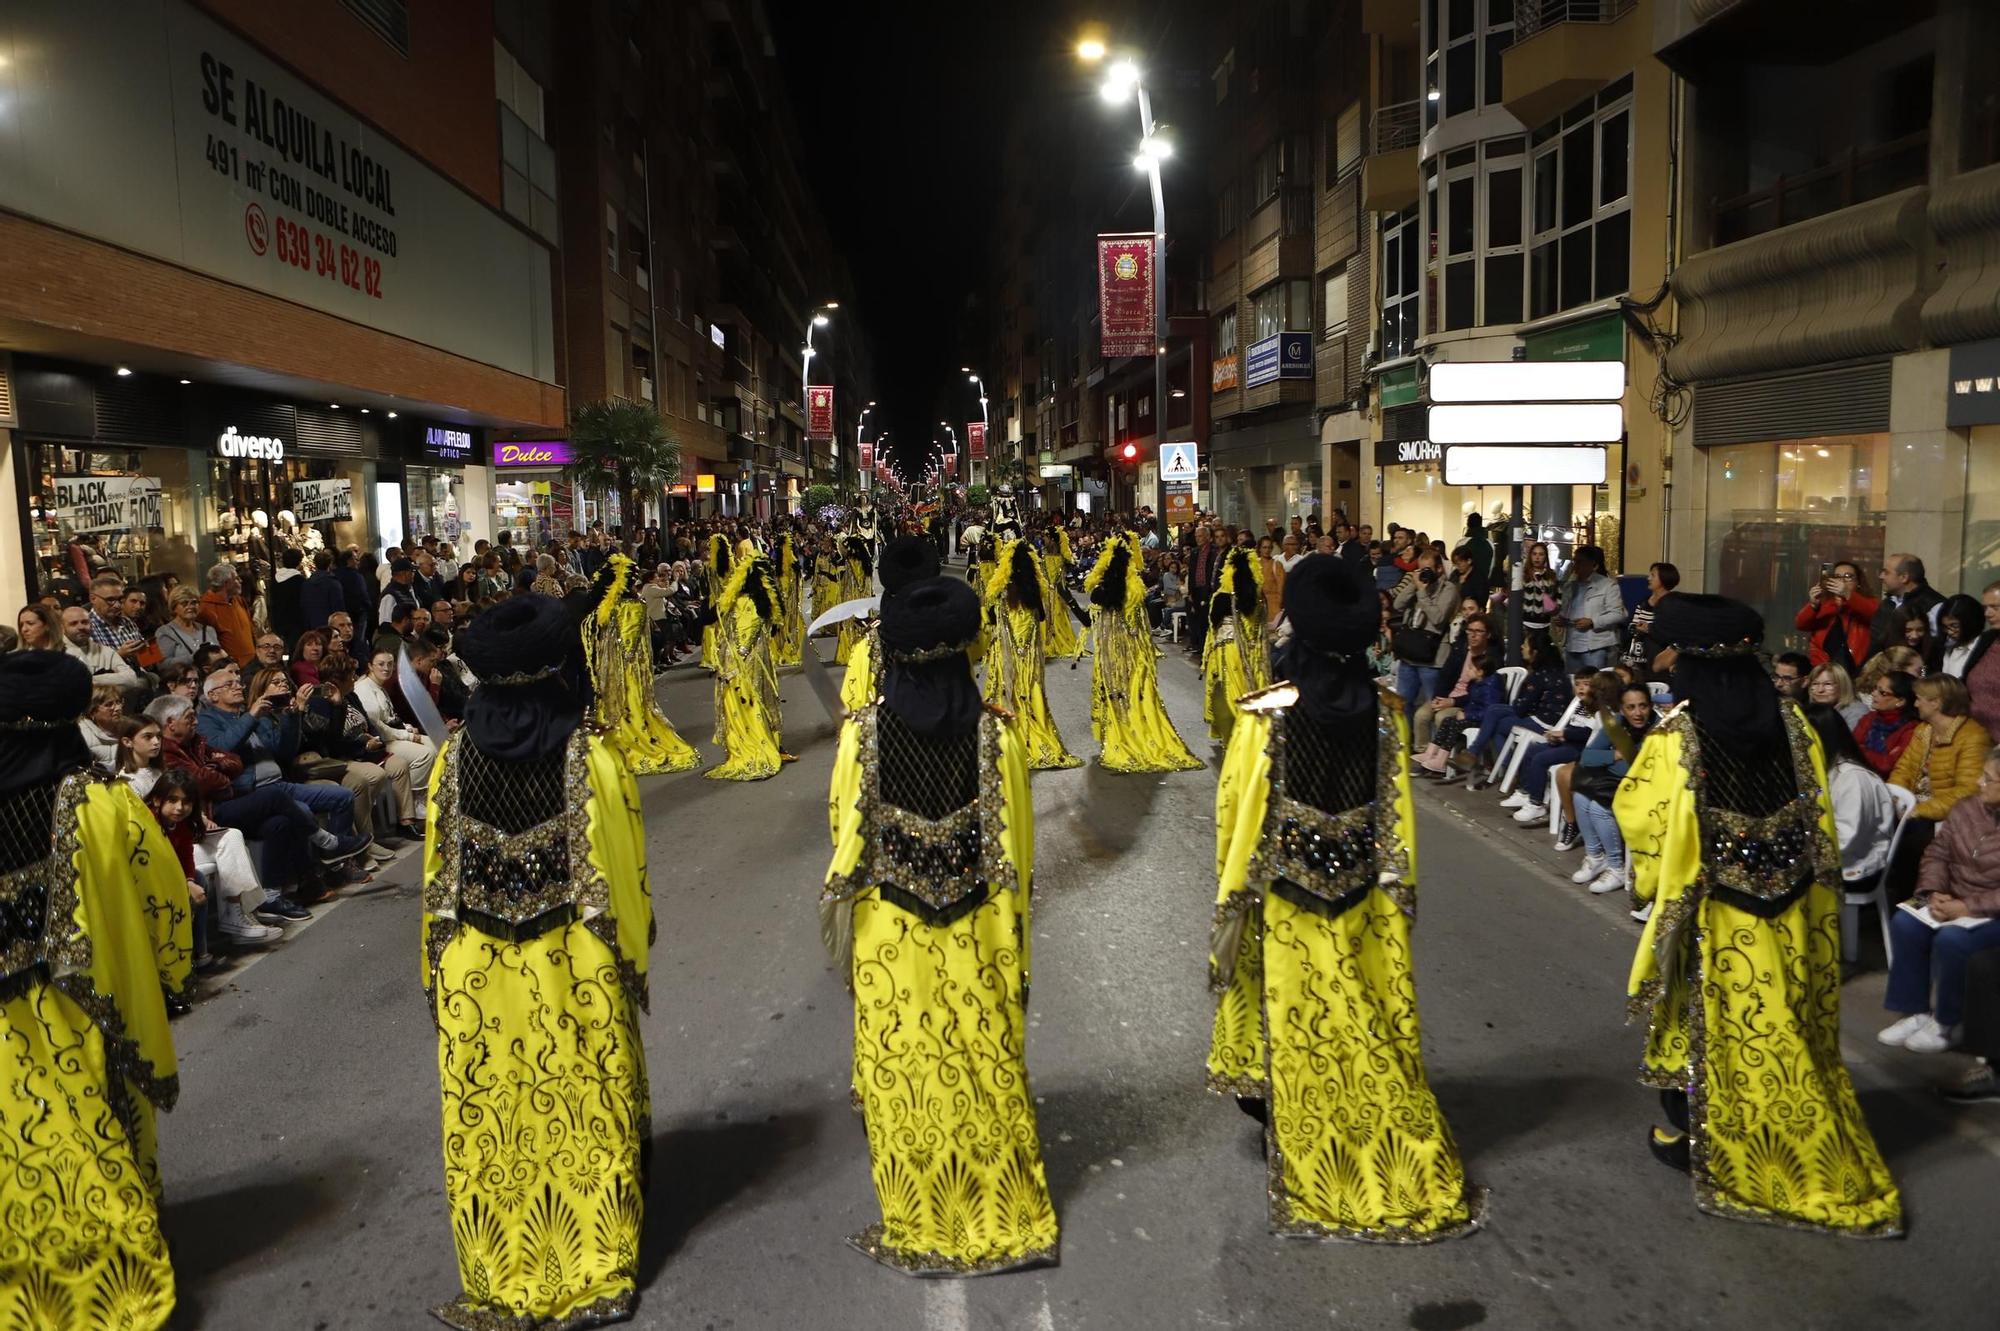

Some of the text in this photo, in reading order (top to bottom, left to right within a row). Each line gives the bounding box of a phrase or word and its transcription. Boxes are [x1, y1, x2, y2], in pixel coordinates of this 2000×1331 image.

[201, 51, 396, 217] SE ALQUILA LOCAL
[206, 134, 239, 181] 491
[269, 167, 302, 213] CON
[306, 186, 349, 236] DOBLE
[352, 212, 397, 258] ACCESO
[276, 216, 383, 300] 639 34 62 82
[219, 425, 284, 462] diverso
[501, 445, 553, 463] Dulce
[57, 481, 107, 508] BLACK
[294, 483, 321, 504] BLACK
[302, 498, 330, 520] FRIDAY
[73, 501, 123, 530] FRIDAY
[129, 494, 161, 528] 50%
